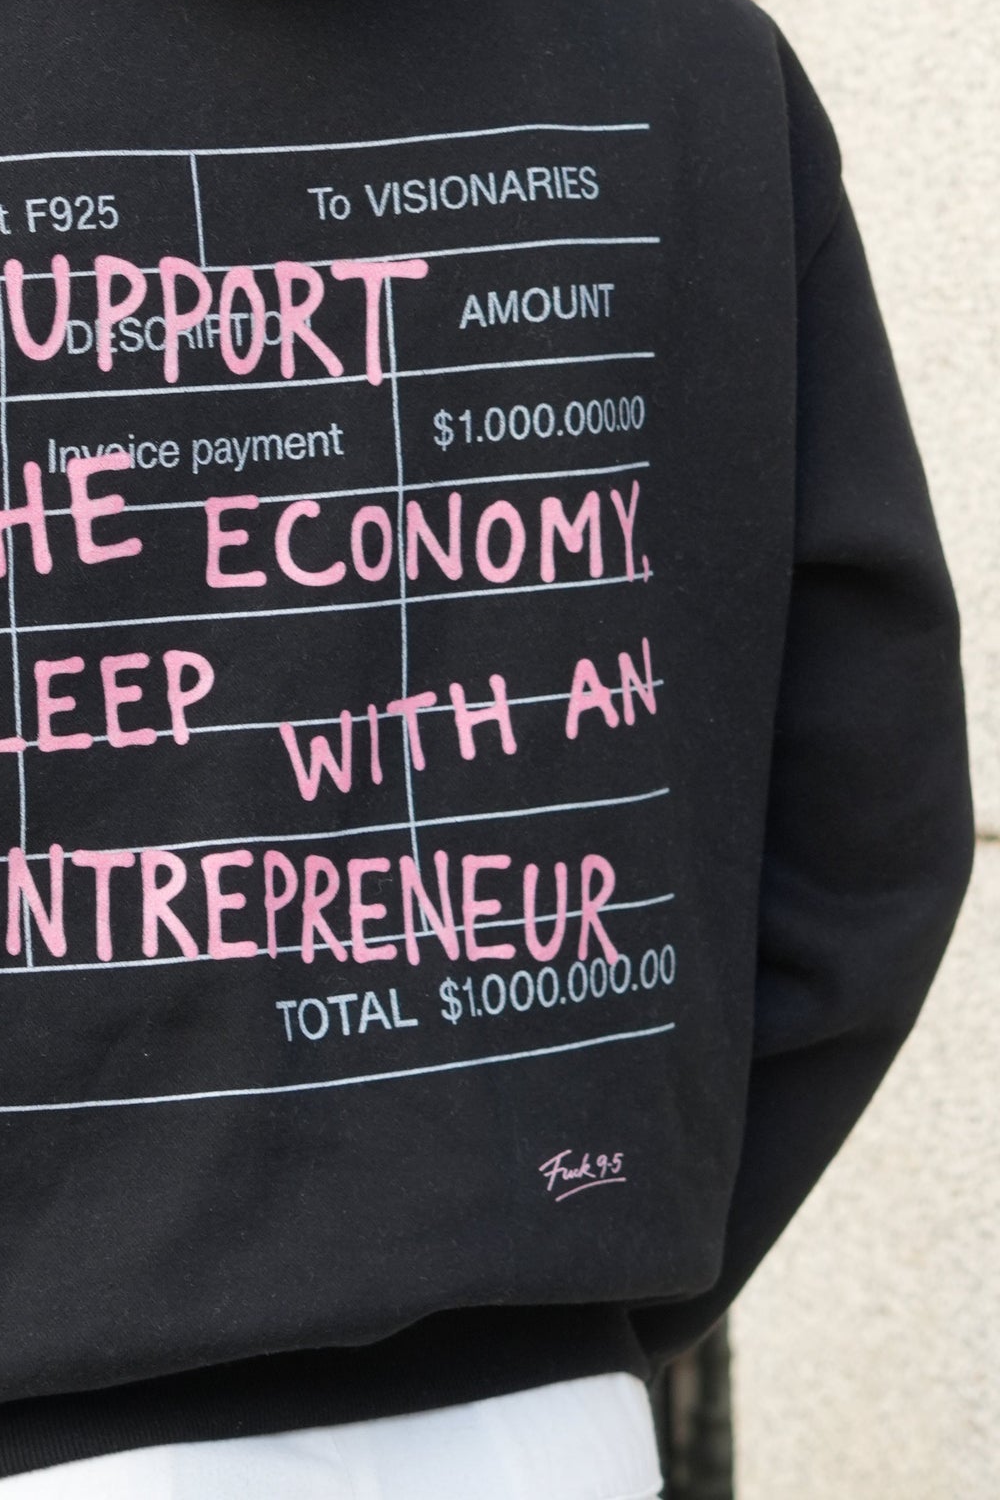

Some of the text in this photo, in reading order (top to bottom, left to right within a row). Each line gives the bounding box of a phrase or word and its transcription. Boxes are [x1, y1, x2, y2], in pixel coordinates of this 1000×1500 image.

[25, 194, 120, 234] F925
[306, 165, 600, 221] To VISIONARIES
[458, 283, 615, 330] AMOUNT
[191, 422, 345, 475] payment
[433, 395, 646, 452] $1.000.000.00
[279, 674, 517, 802] WITH
[565, 637, 657, 740] AN
[275, 944, 677, 1042] TOTAL $1.000.000.00
[538, 1149, 596, 1192] Fuck
